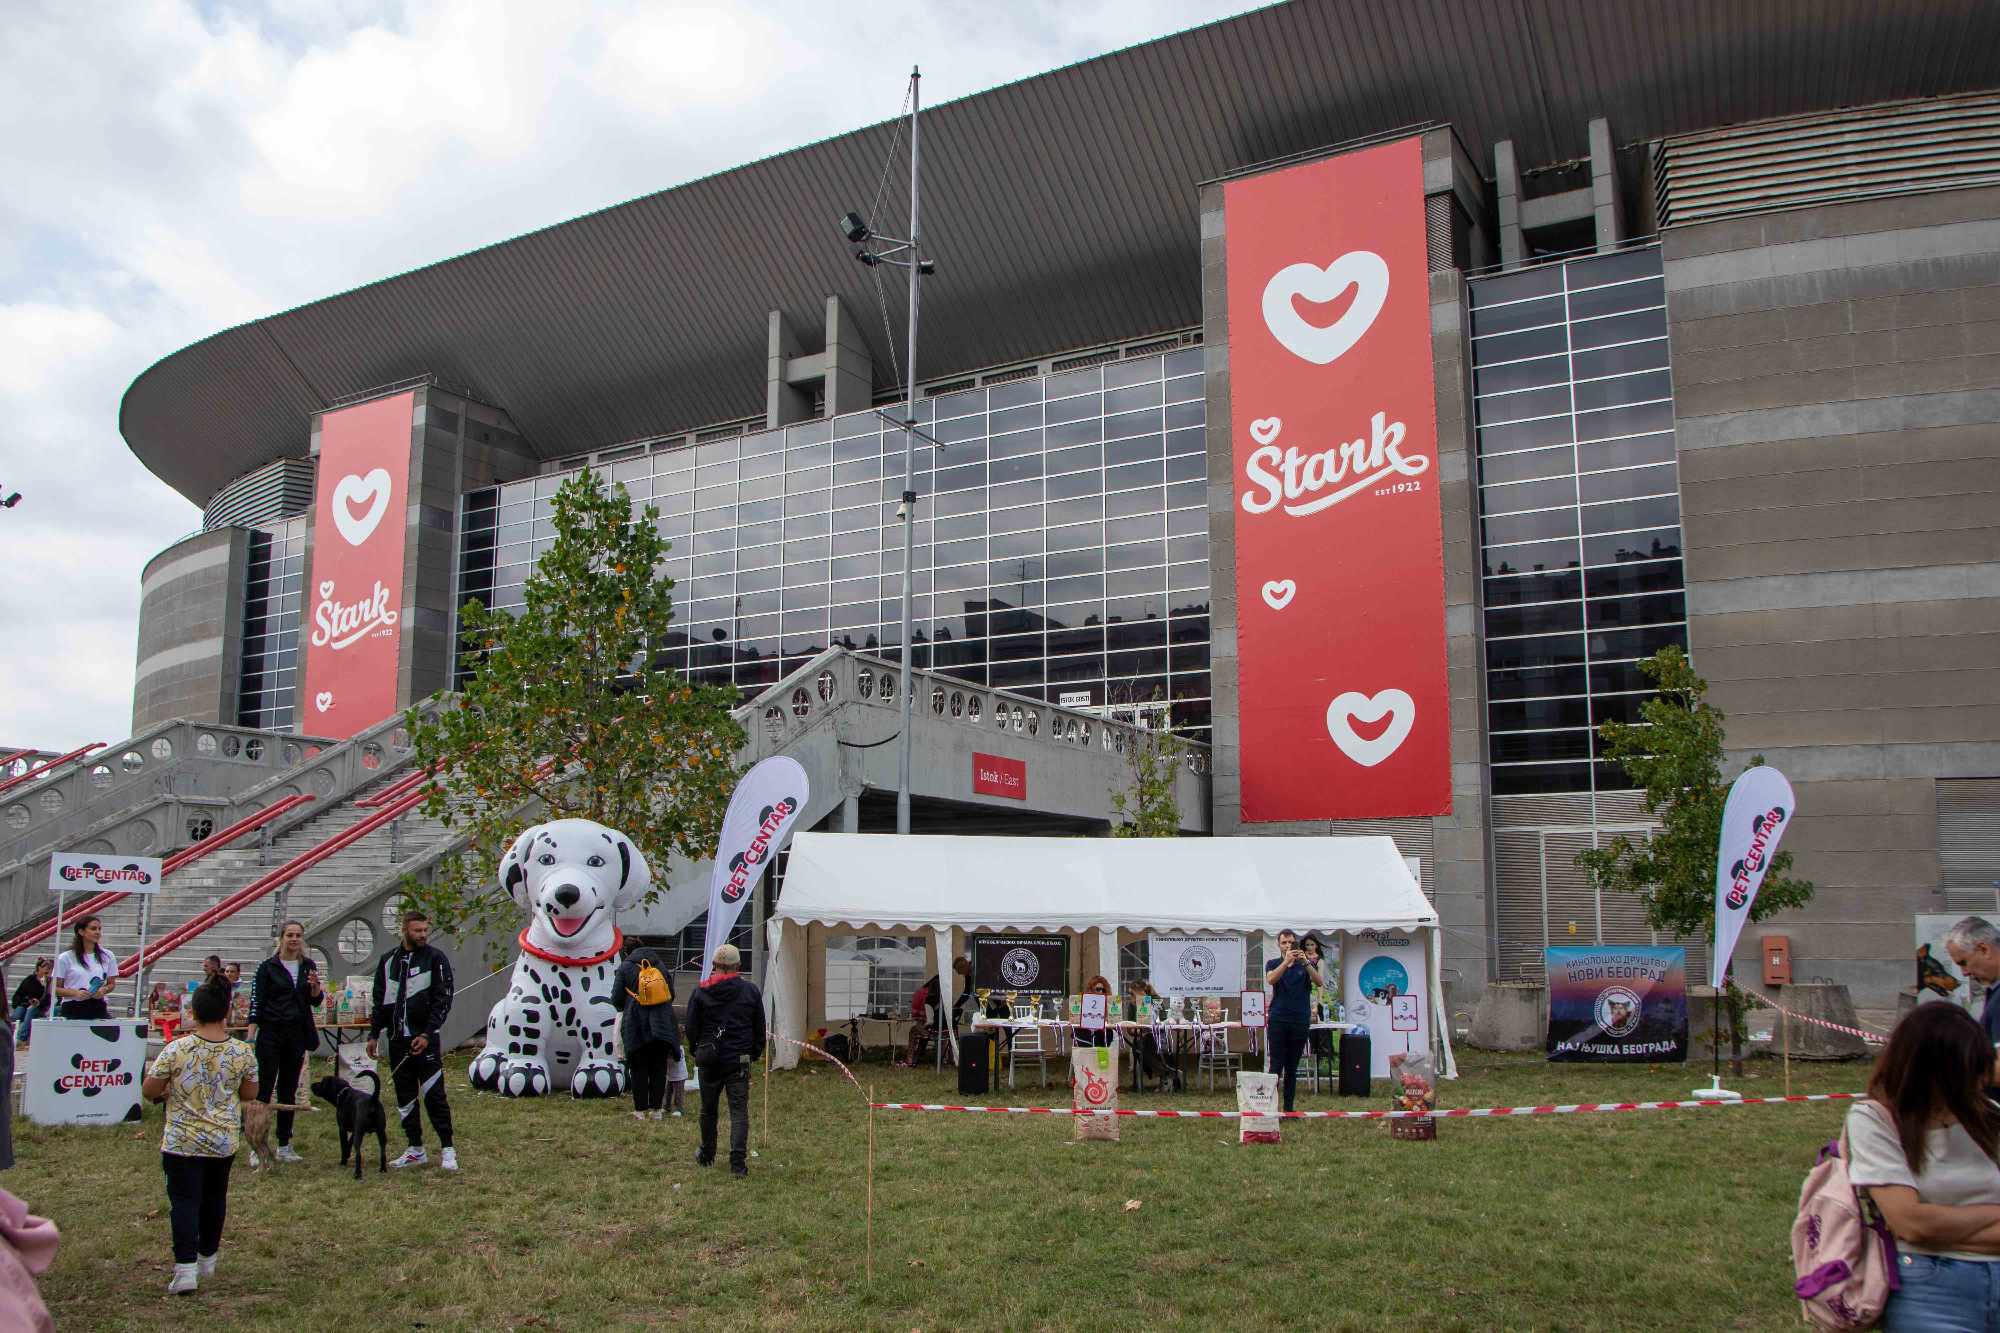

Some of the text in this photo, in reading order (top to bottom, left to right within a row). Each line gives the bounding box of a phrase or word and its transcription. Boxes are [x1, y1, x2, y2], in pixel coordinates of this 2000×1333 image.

[1375, 481, 1422, 496] EST 1922
[725, 801, 792, 897] PET CENTAR
[1730, 811, 1781, 904] PET CENTAR
[65, 868, 146, 881] PET CENTAR
[1568, 966, 1665, 982] НОВИ БЕОГРАД
[1091, 999, 1097, 1009] 2
[1401, 1000, 1408, 1011] 3
[1622, 1039, 1677, 1055] БЕОГРАДА
[81, 1060, 110, 1072] PET
[62, 1074, 124, 1088] CENTAR
